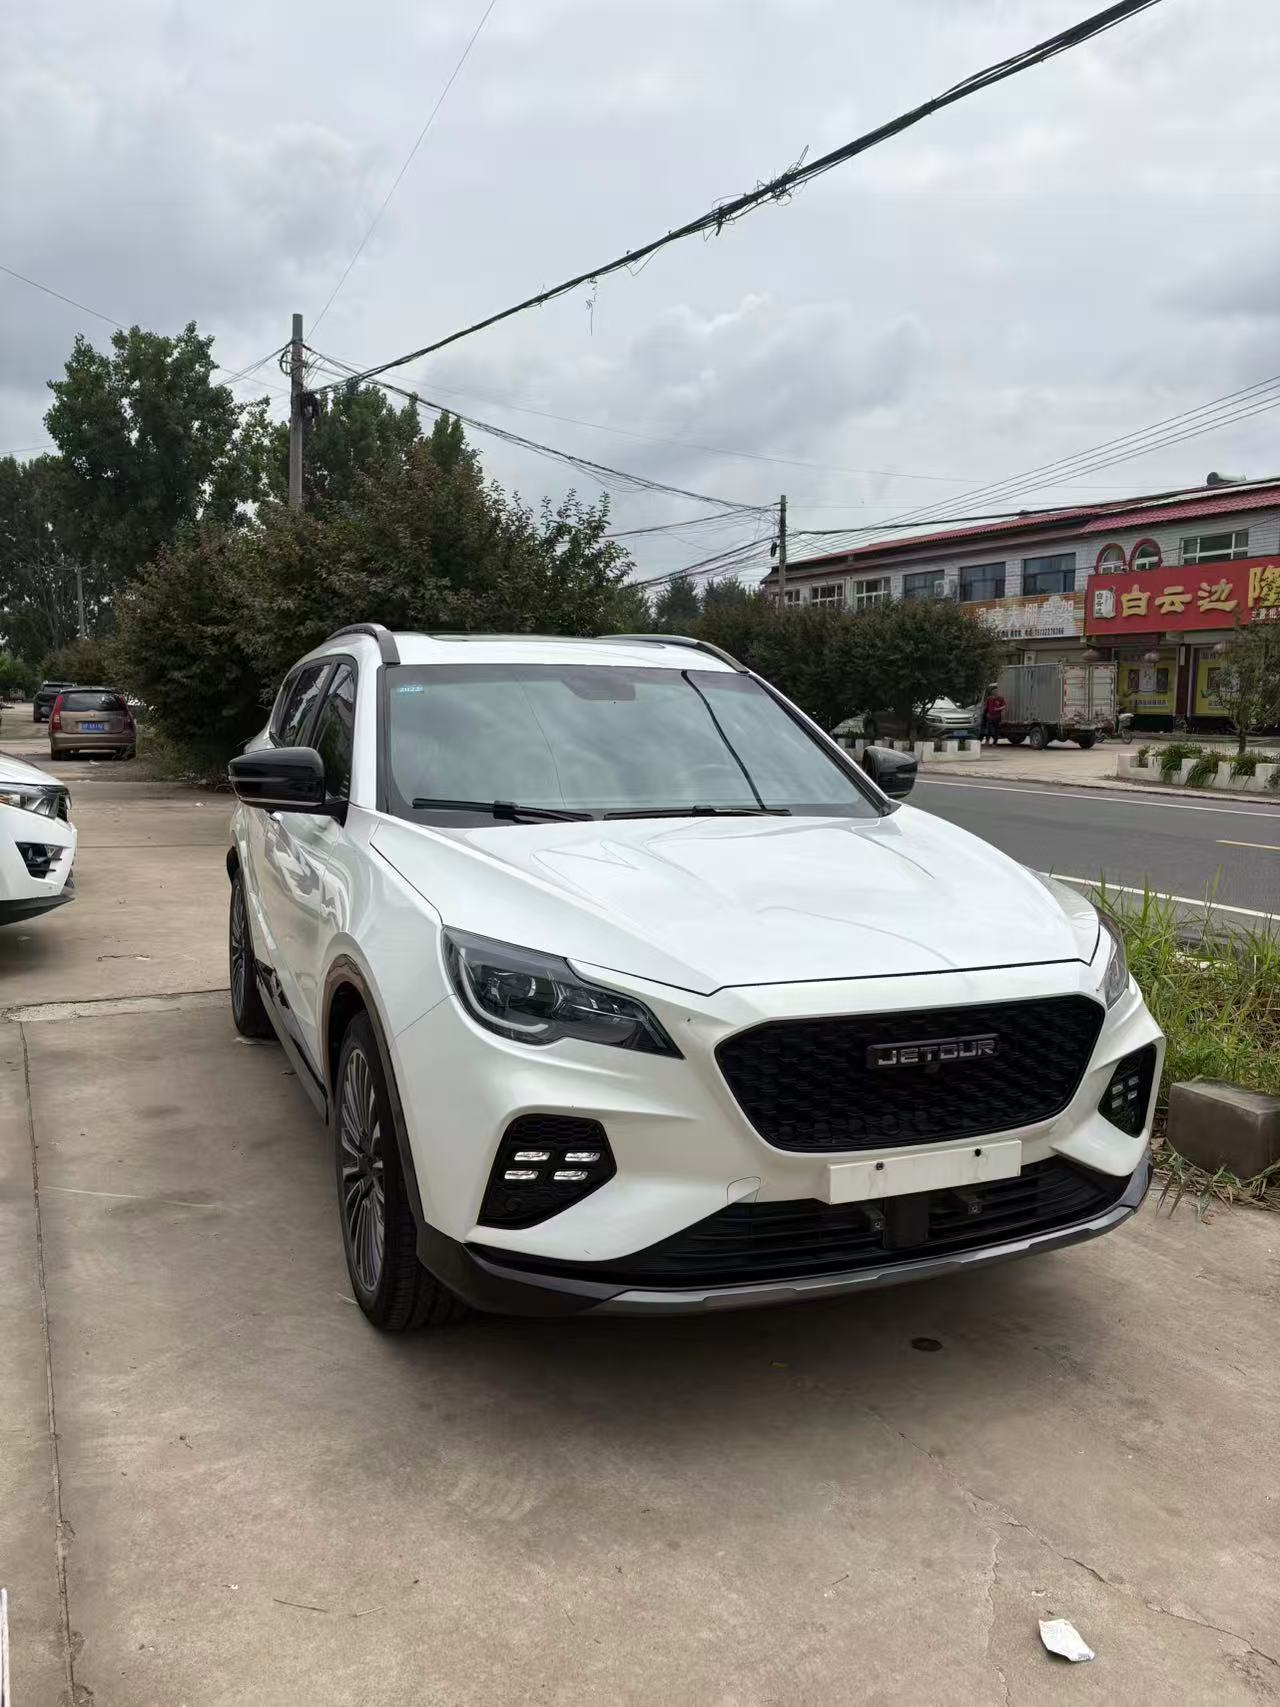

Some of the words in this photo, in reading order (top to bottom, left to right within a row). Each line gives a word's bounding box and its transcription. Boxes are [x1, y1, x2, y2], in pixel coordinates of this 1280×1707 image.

[1120, 578, 1238, 617] 白云边
[878, 1039, 995, 1065] JETOUR
